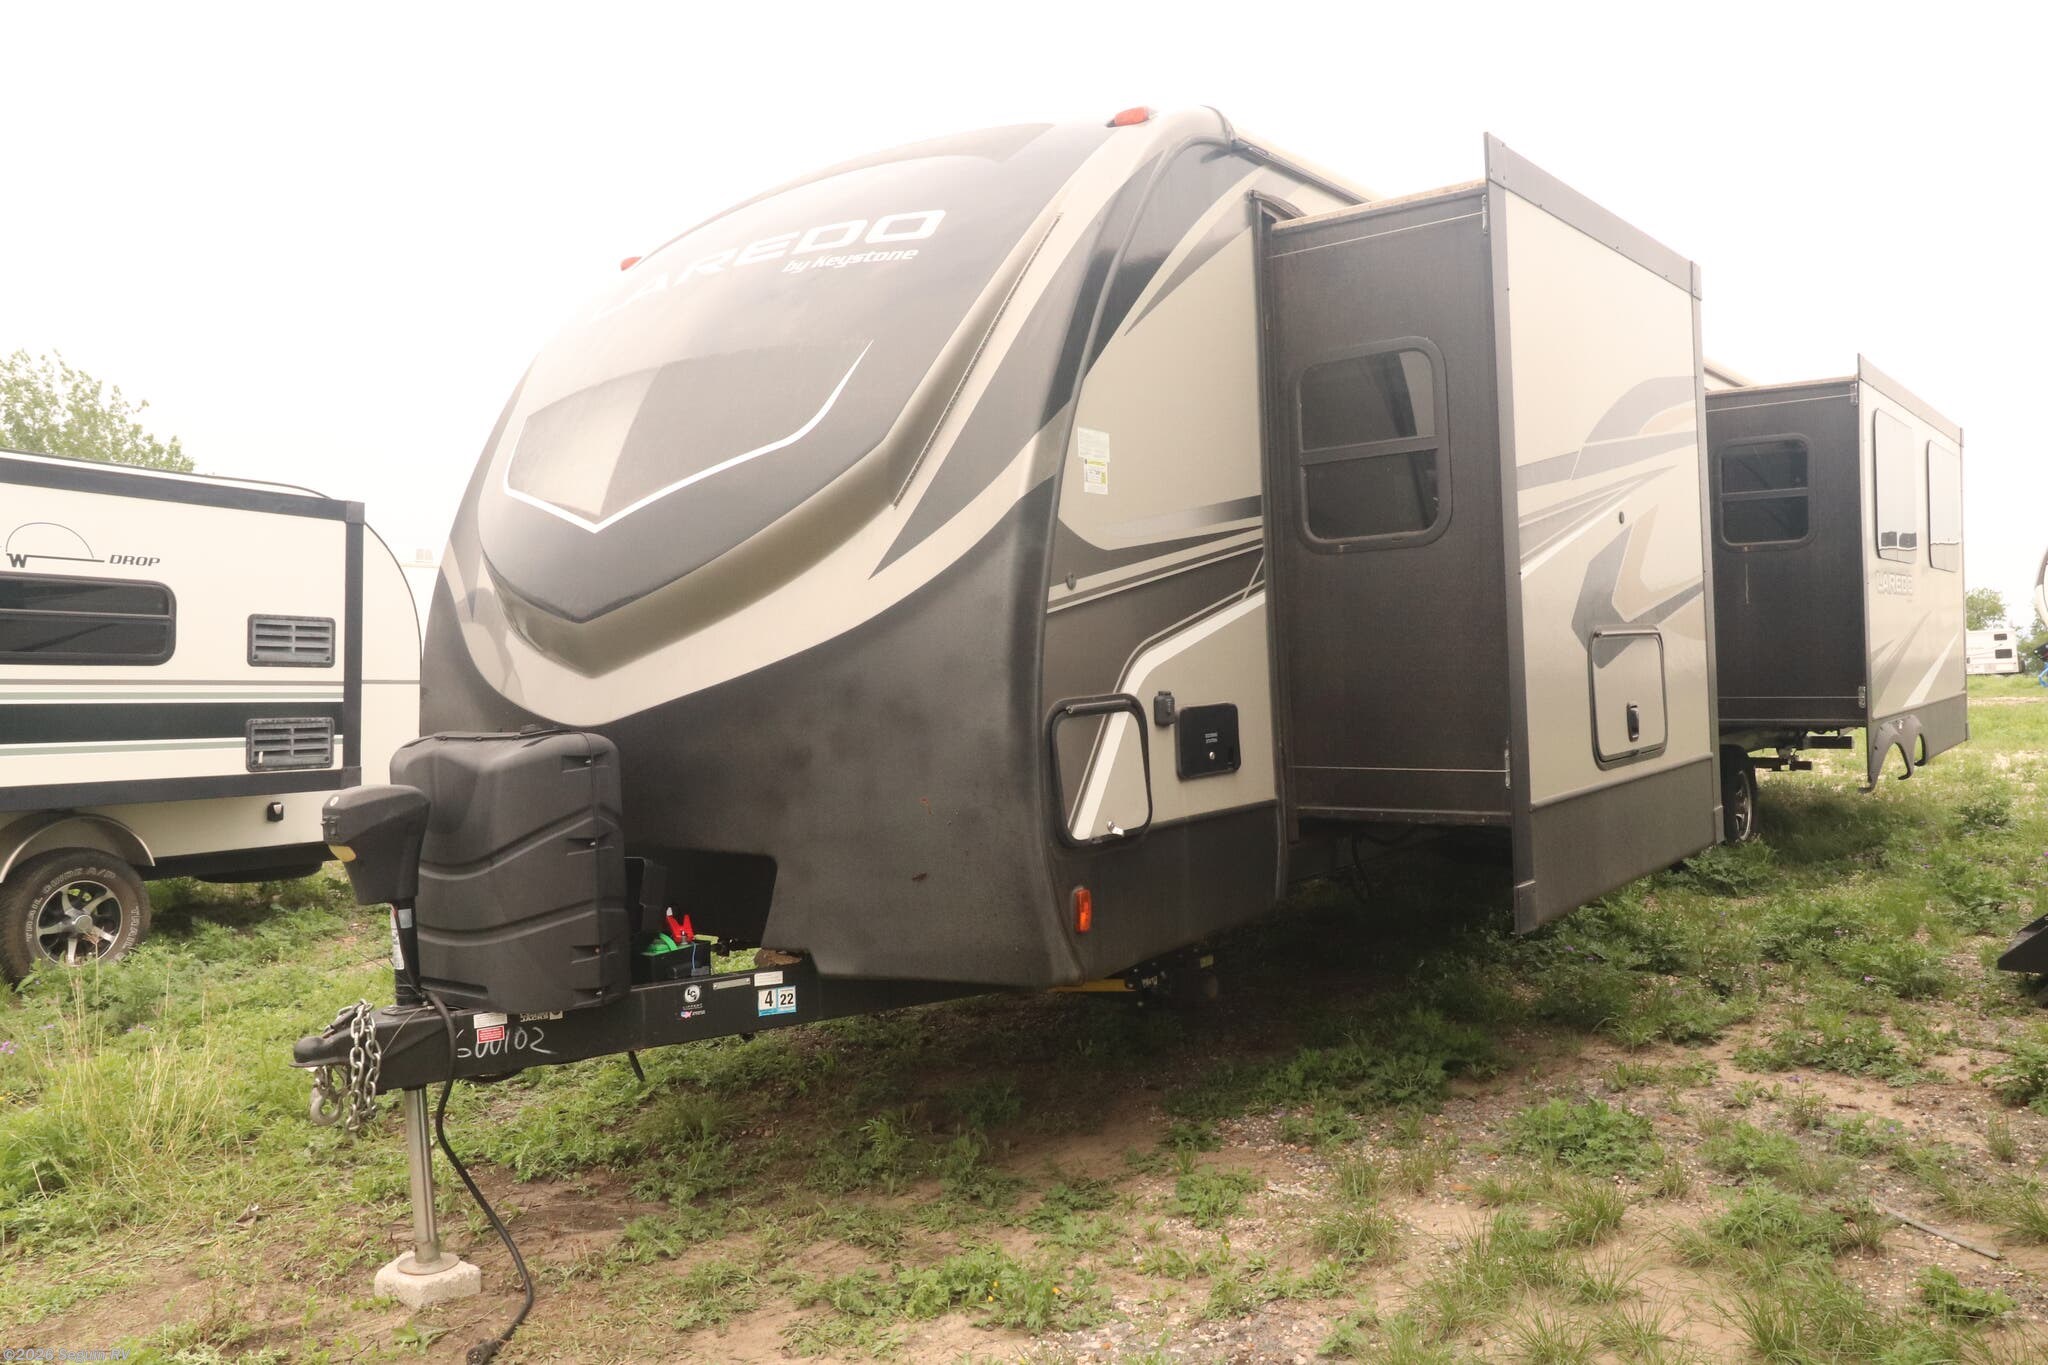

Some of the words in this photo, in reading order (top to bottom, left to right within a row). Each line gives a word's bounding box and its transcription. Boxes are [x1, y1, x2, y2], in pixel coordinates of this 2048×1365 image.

[782, 260, 810, 274] by
[812, 250, 919, 268] Keystone
[109, 554, 161, 566] DROP
[765, 991, 773, 1006] 4
[780, 993, 793, 1005] 22
